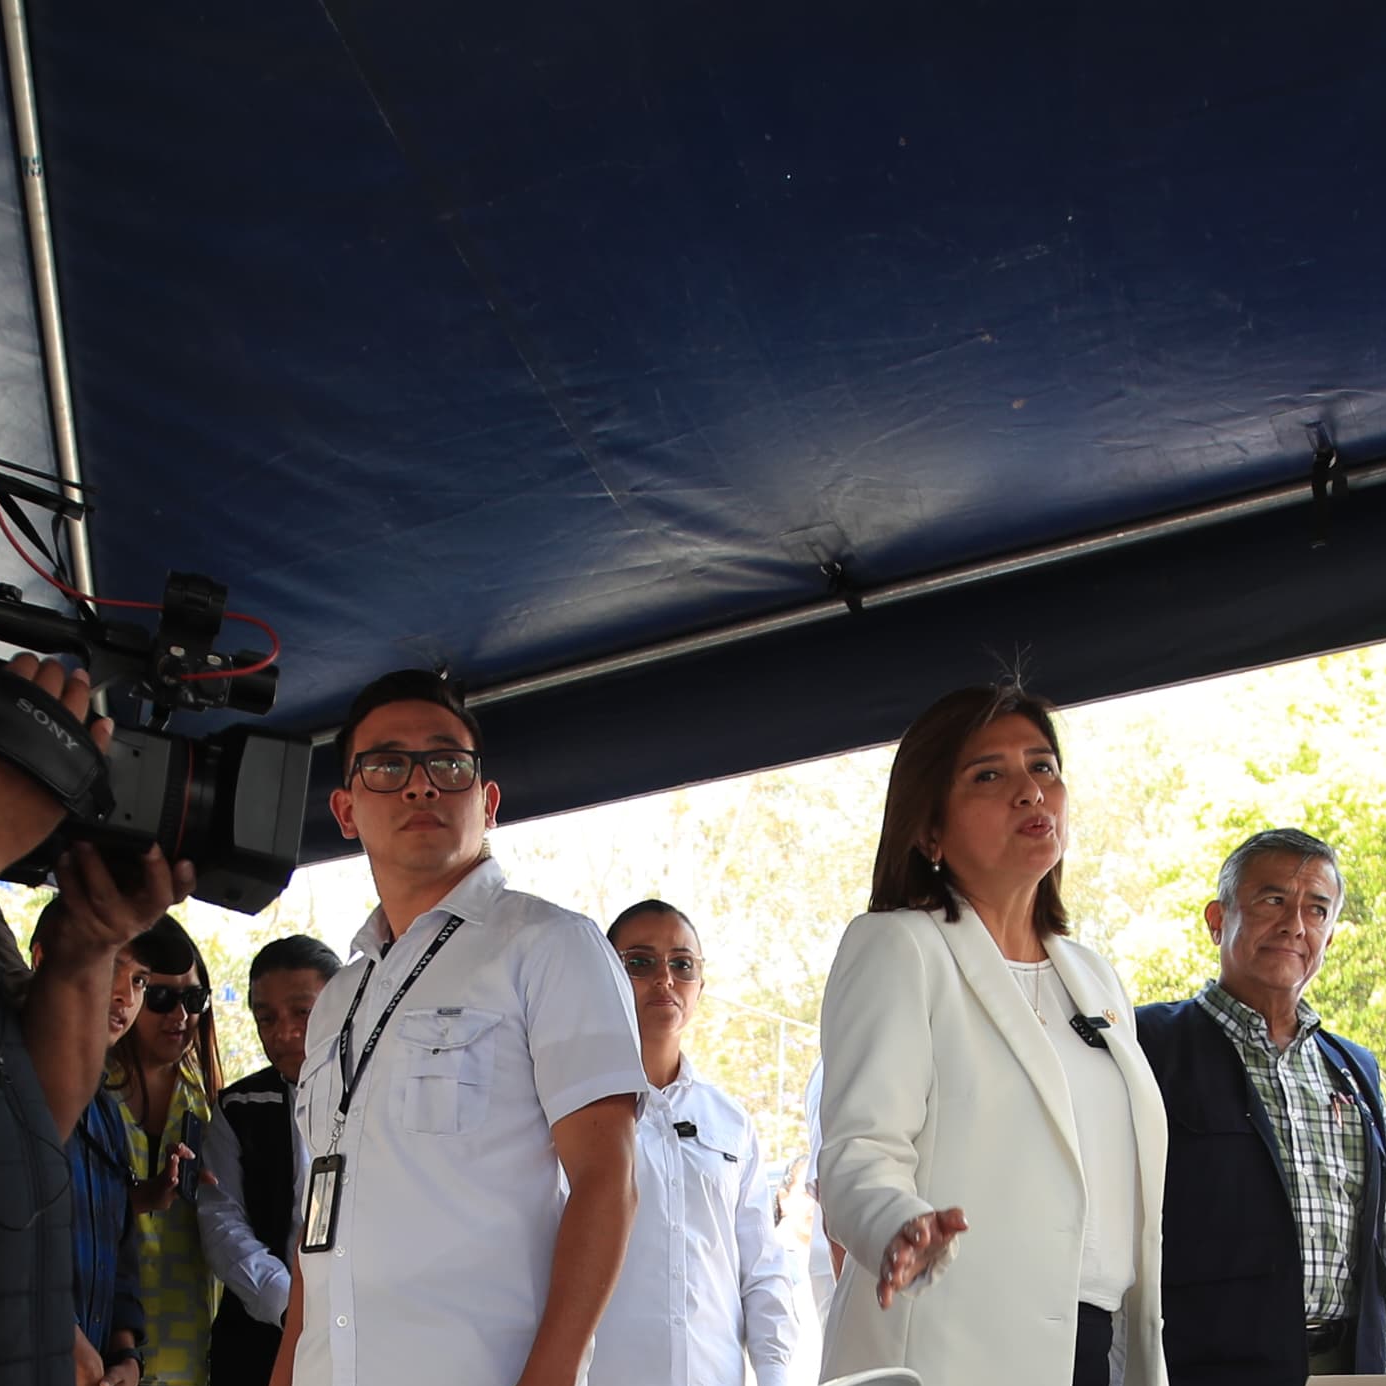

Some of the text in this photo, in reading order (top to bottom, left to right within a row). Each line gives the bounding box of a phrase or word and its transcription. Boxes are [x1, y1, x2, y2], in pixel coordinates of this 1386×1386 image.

[16, 698, 79, 750] SONY
[438, 919, 460, 942] SAAS
[412, 953, 432, 976] SAAS
